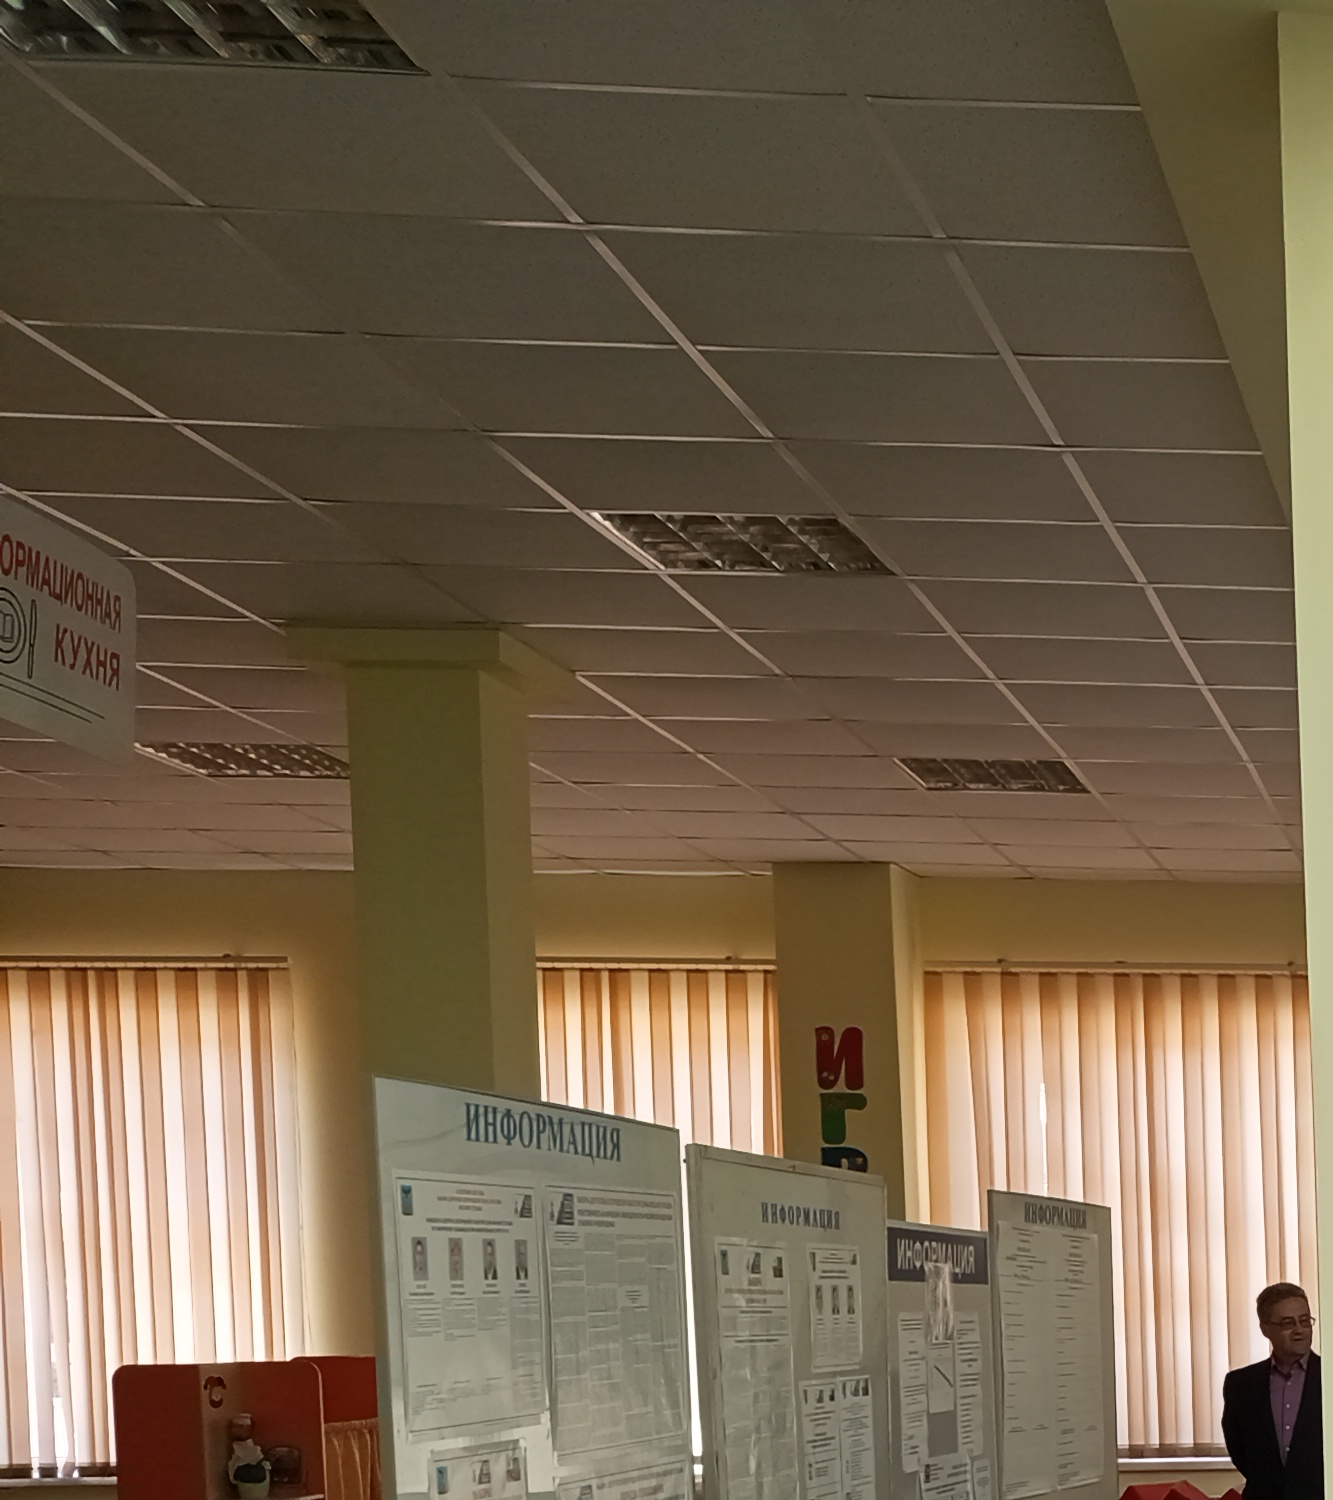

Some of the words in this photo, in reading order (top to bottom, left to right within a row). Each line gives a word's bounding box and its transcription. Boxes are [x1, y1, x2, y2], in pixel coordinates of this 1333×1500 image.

[54, 623, 120, 691] КУХНЯ
[465, 1102, 622, 1165] ИНФОРМАЦИЯ
[761, 1202, 840, 1231] ИНФОРМАЦИЯ
[1024, 1201, 1087, 1231] ИНФОРМАЦИЯ
[897, 1238, 976, 1279] ИНФОРМАЦИЯ
